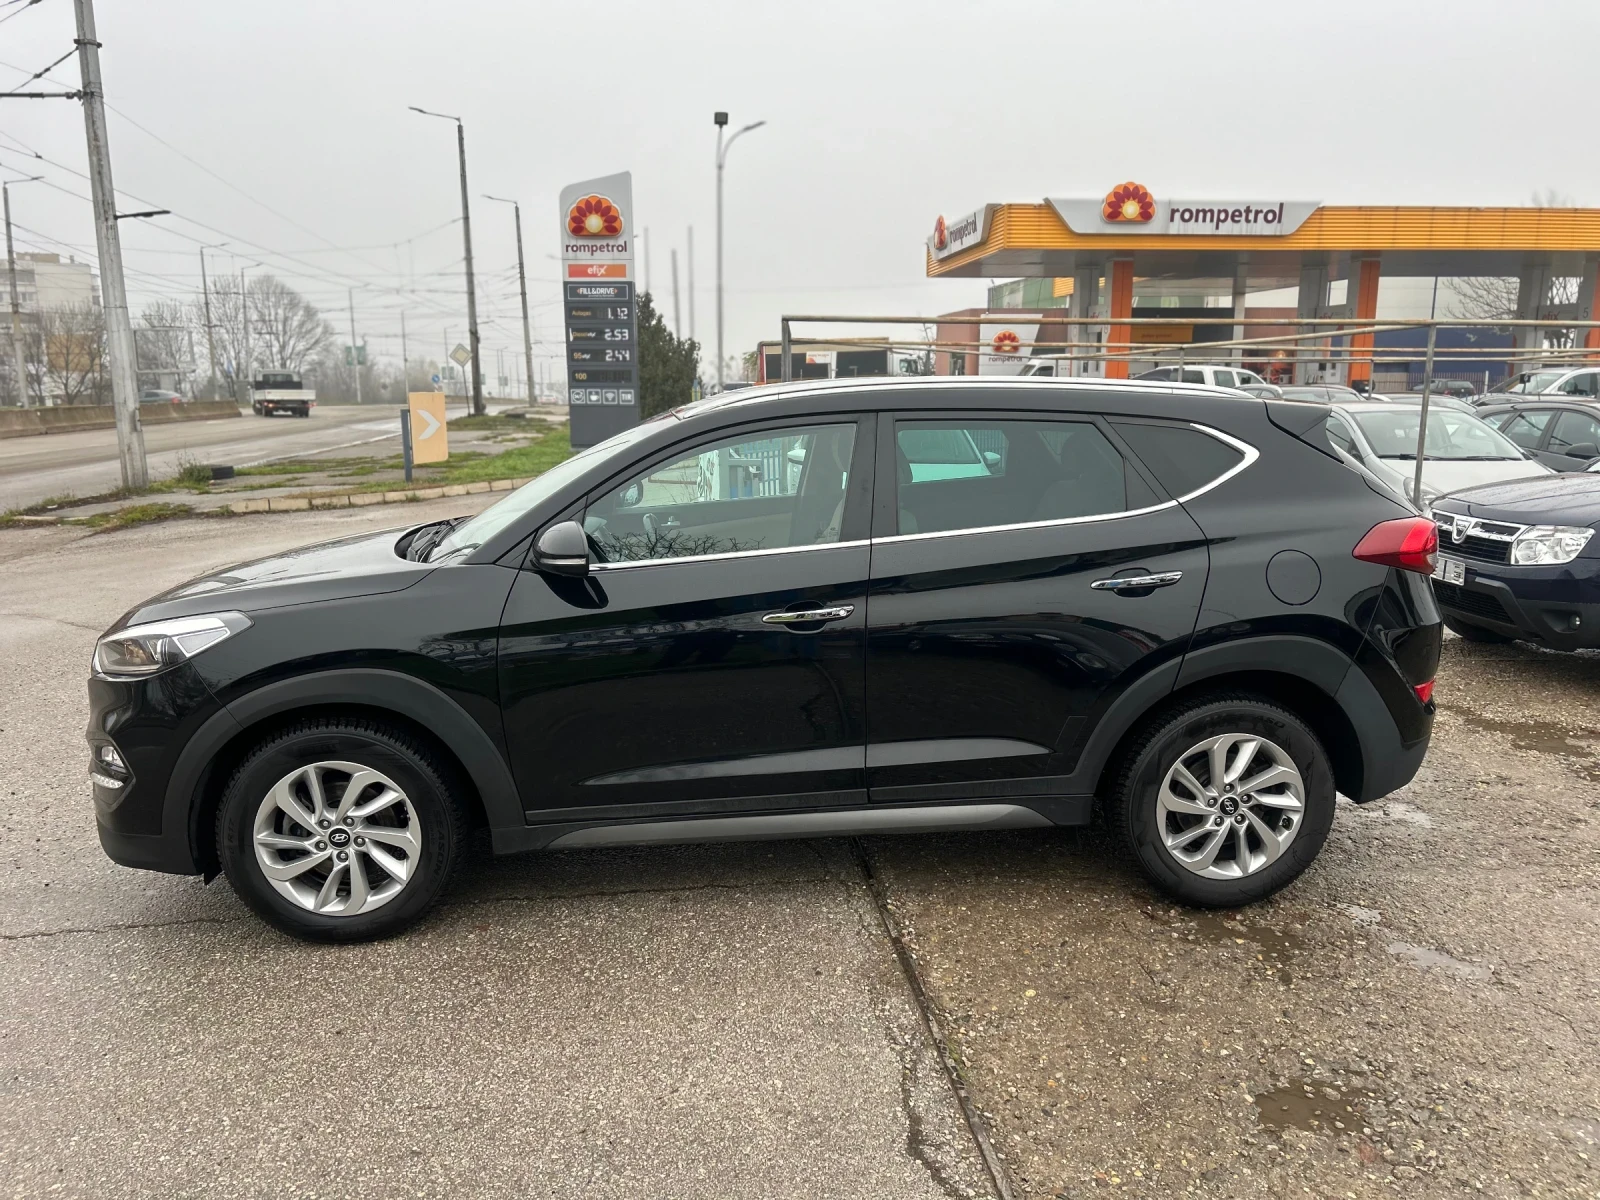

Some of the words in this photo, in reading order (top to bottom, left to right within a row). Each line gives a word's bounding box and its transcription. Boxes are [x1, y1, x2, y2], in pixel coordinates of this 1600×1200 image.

[1170, 202, 1284, 230] rompetrol
[949, 212, 978, 245] rompetrol
[565, 240, 628, 256] rompetrol
[587, 265, 608, 276] efix
[579, 287, 615, 295] FILL&DRIVE
[1582, 307, 1589, 319] 5
[604, 328, 630, 341] 2.53
[605, 349, 630, 361] 2.44
